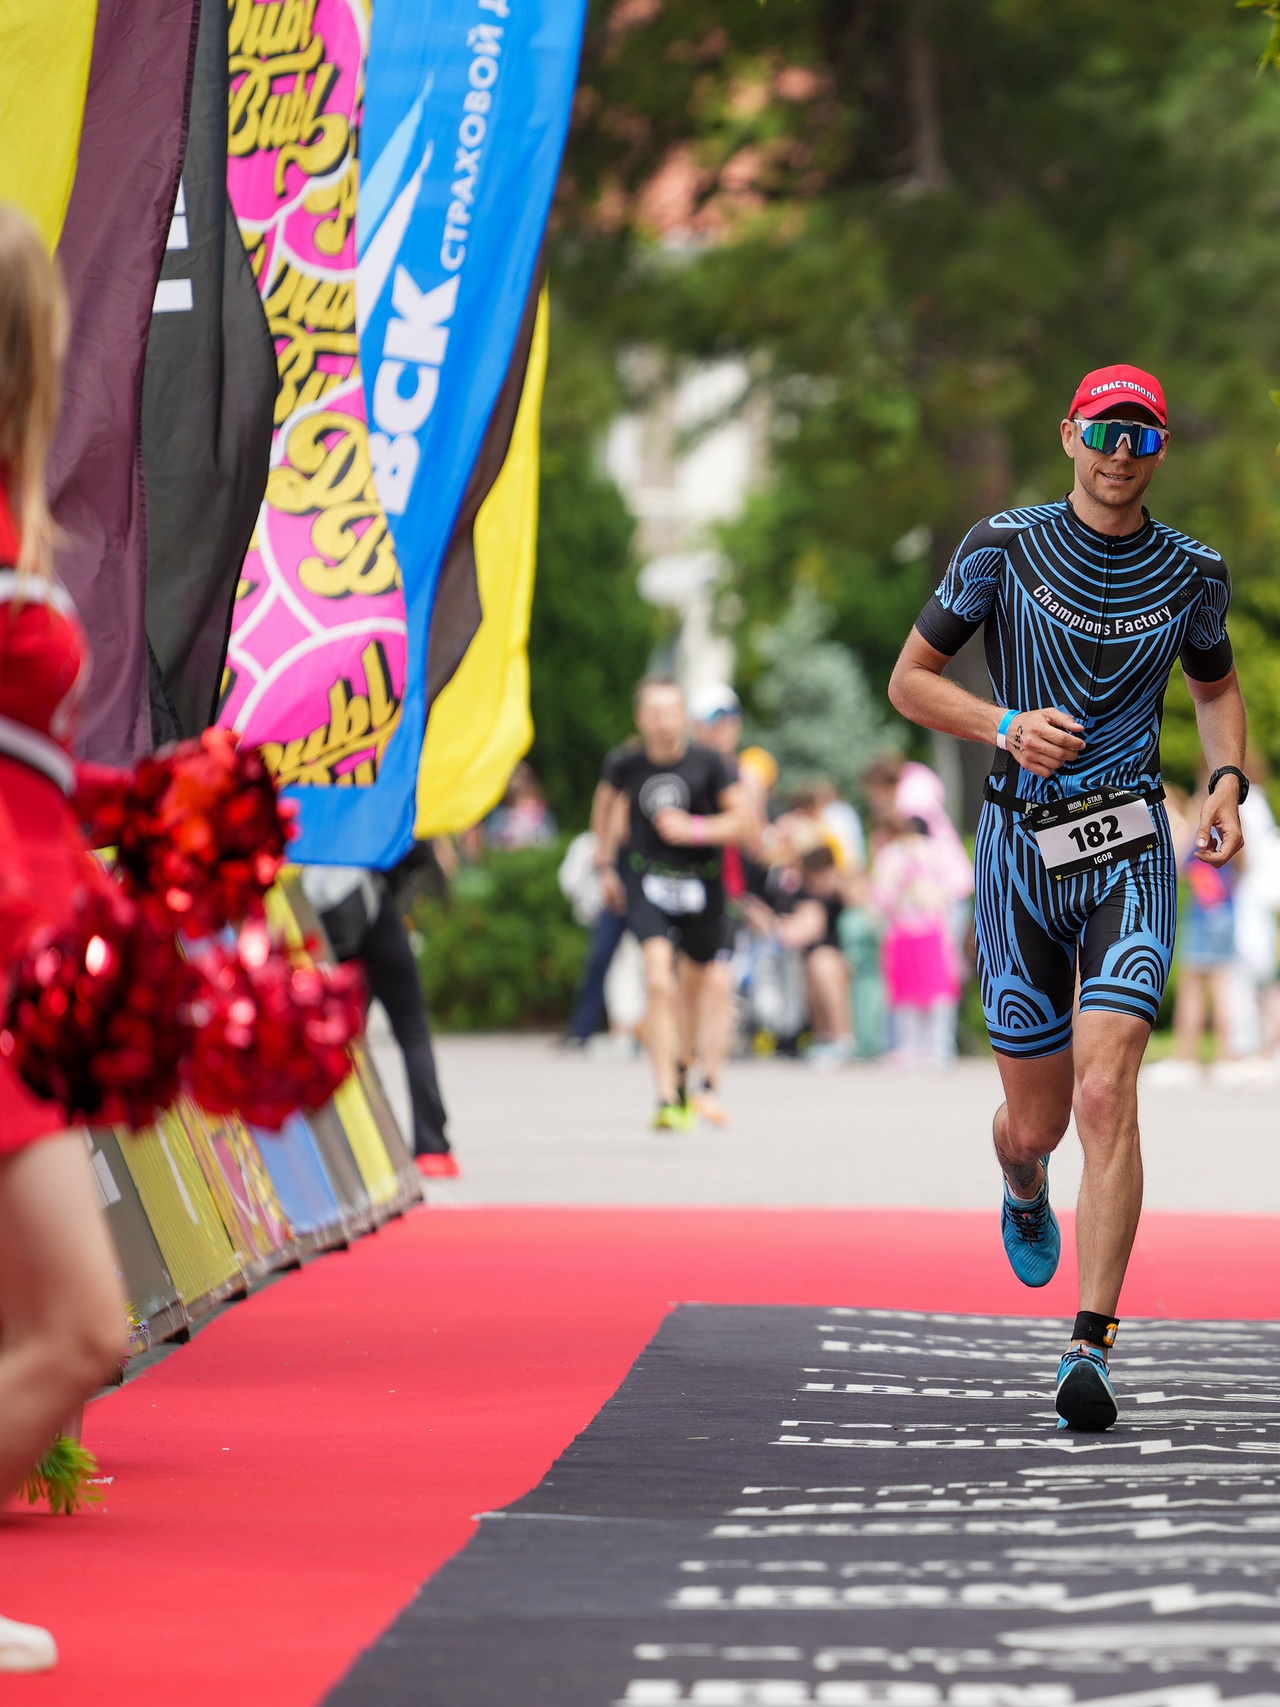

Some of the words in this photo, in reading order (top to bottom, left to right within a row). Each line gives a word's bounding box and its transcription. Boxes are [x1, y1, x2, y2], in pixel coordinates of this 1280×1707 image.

[368, 264, 461, 517] ВСК
[440, 23, 505, 272] СТРАХОВОЙ
[1091, 381, 1157, 403] СЕВАСТОПОЛЬ
[1033, 584, 1111, 636] Champions
[1115, 605, 1172, 635] Factory
[1087, 794, 1103, 805] STAR
[1068, 814, 1123, 853] 182
[1093, 851, 1113, 865] IGOR
